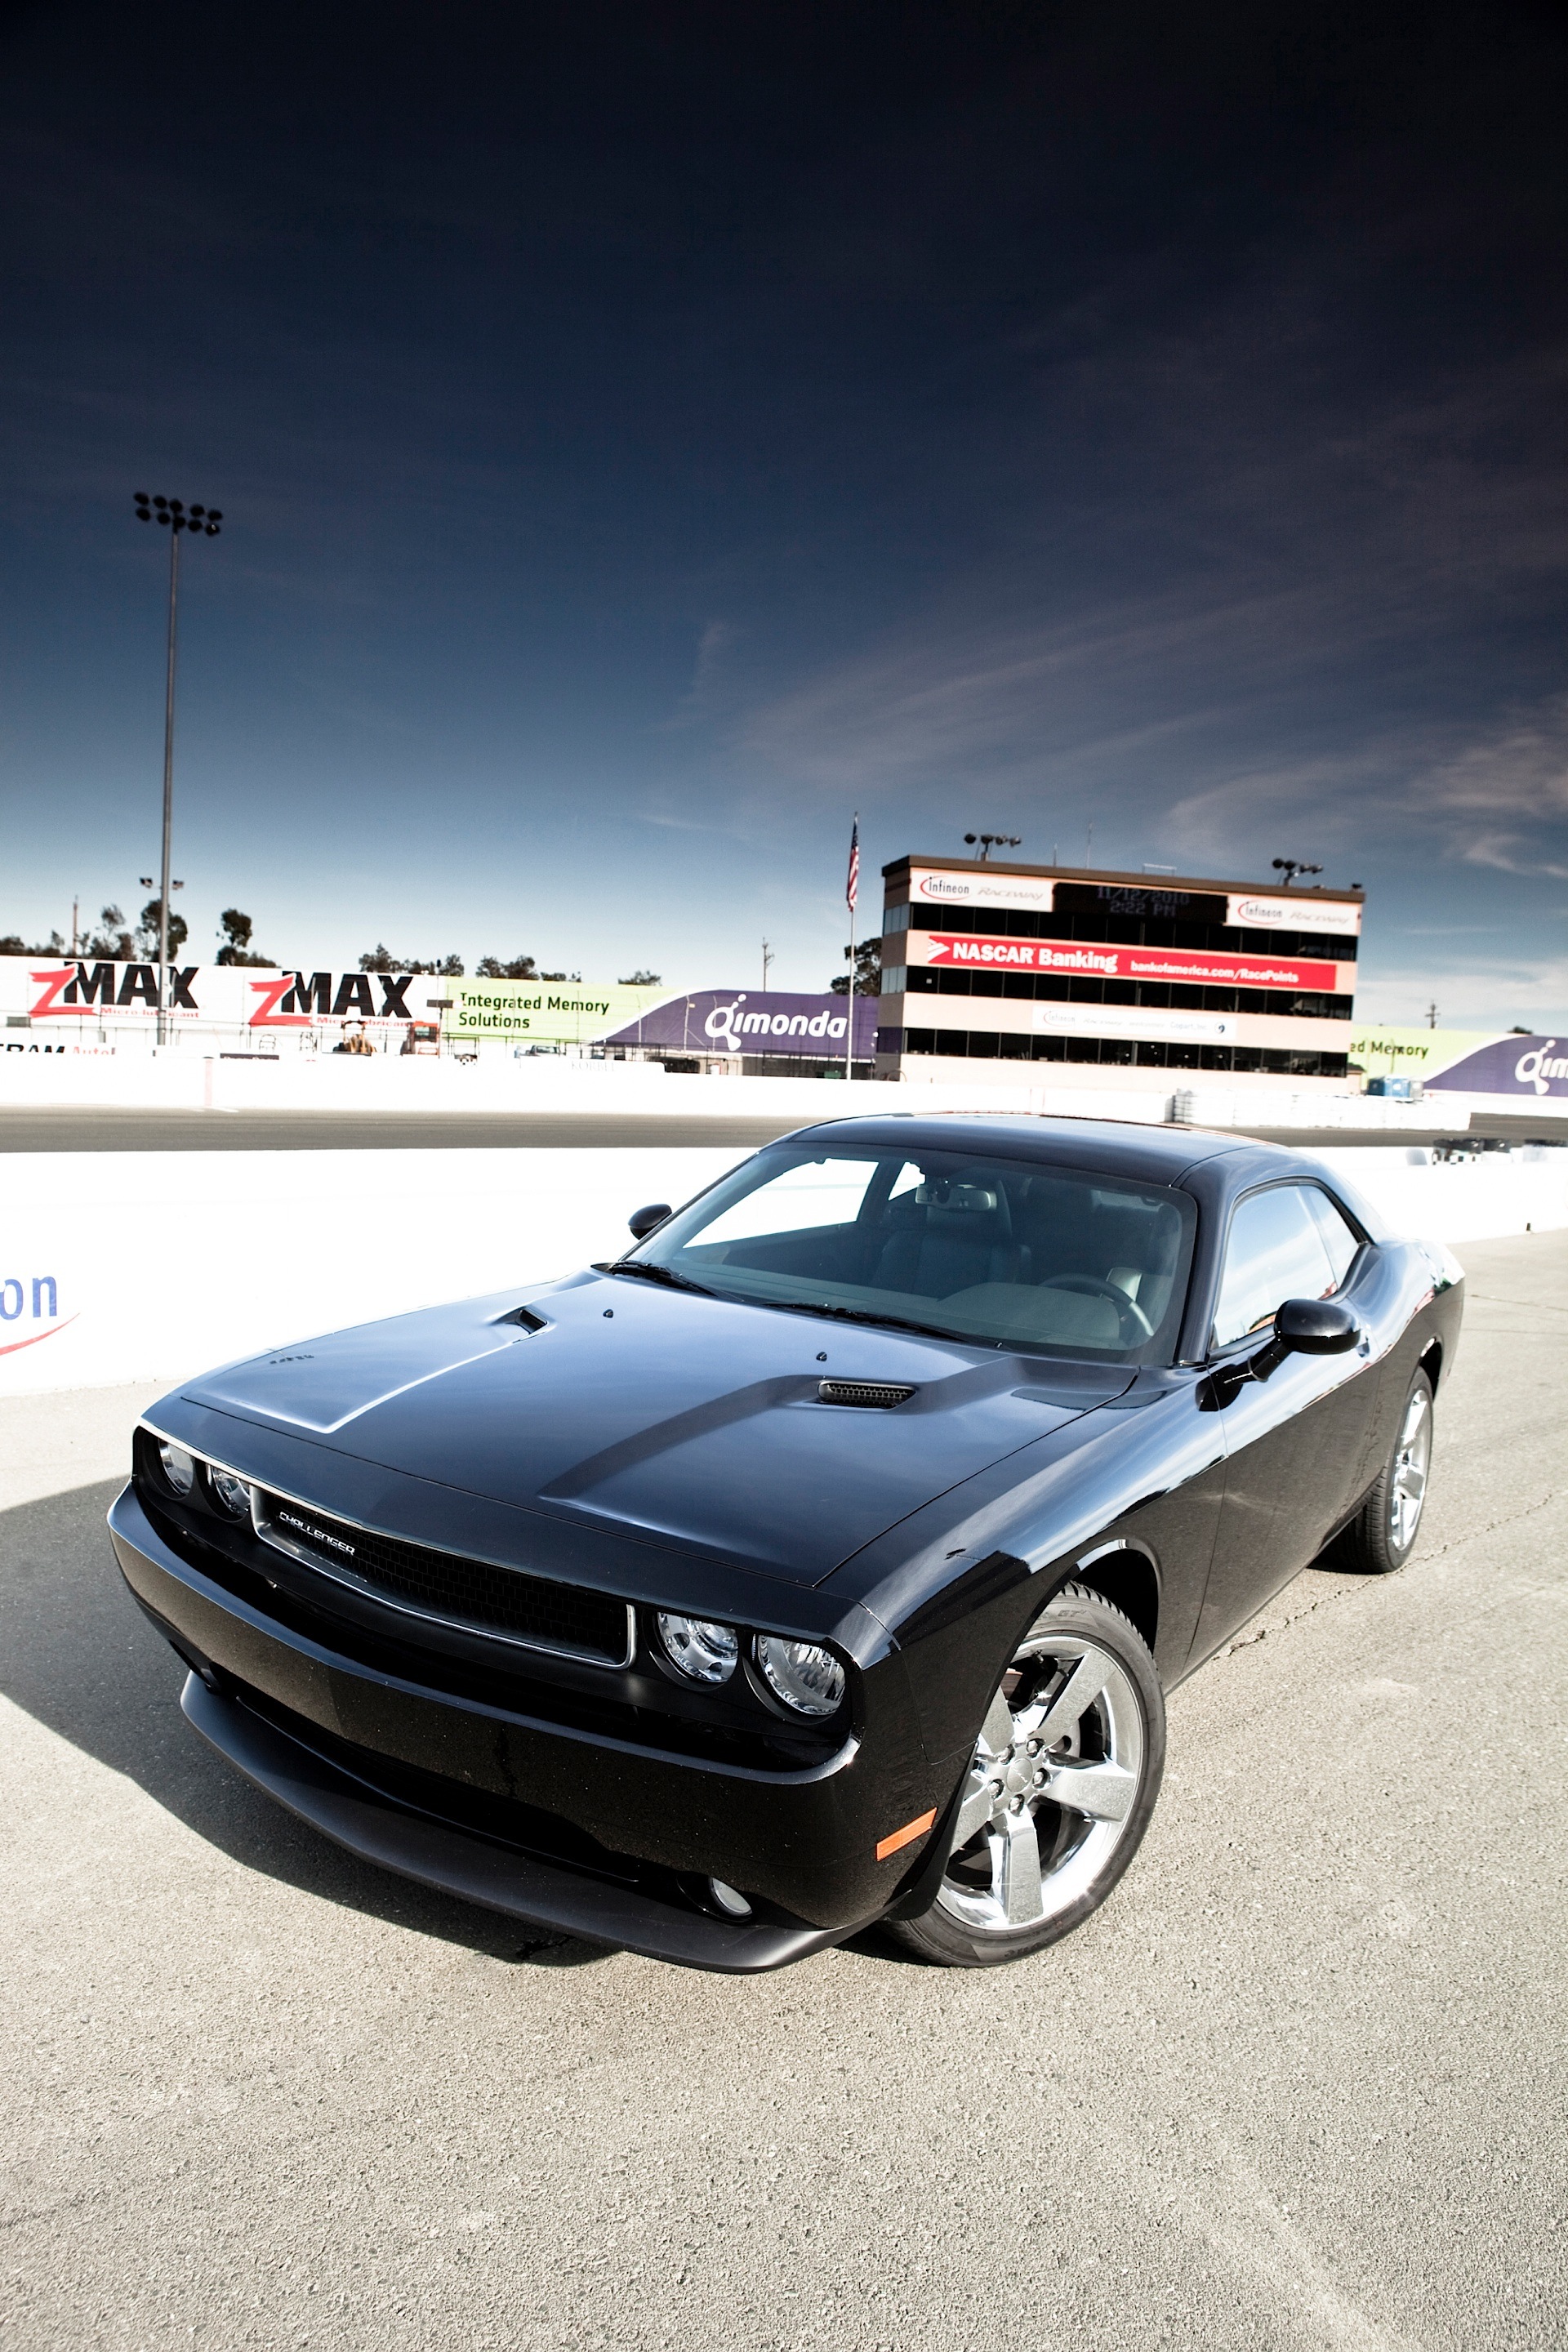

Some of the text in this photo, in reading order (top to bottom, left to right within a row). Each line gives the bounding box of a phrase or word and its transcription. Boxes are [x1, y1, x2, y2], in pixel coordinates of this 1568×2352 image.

[1110, 901, 1176, 917] 2:22 PM
[1038, 948, 1118, 973] Banking
[461, 992, 610, 1015] Integrated Memory
[459, 1012, 530, 1028] Solutions
[1371, 1040, 1429, 1059] Memory
[279, 1512, 356, 1556] CHALLENGER
